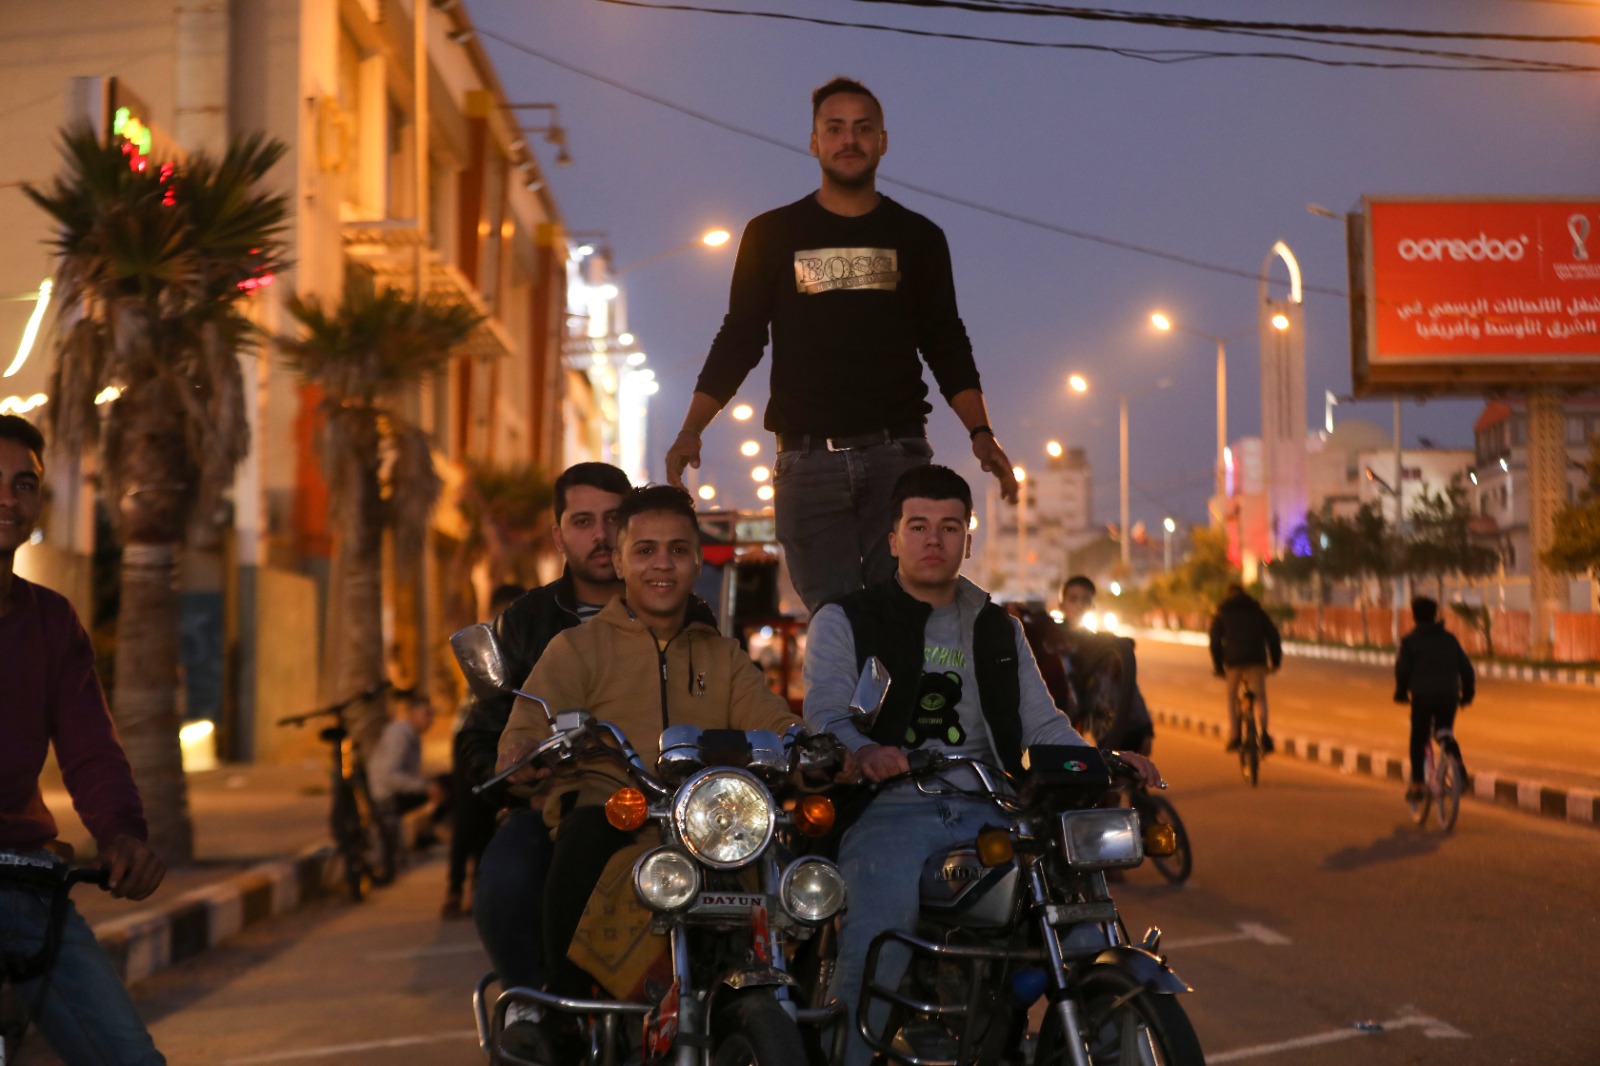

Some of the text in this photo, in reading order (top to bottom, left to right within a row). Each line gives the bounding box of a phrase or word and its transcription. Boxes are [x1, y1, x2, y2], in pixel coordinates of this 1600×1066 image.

[1398, 232, 1525, 262] ooredoo
[798, 256, 893, 284] BOSS
[858, 273, 895, 284] BOS
[1396, 299, 1423, 321] في
[1428, 297, 1488, 321] الرسمي
[1493, 296, 1562, 313] الاتصالات
[1546, 316, 1597, 339] الشرق
[702, 896, 762, 906] DAYUN
